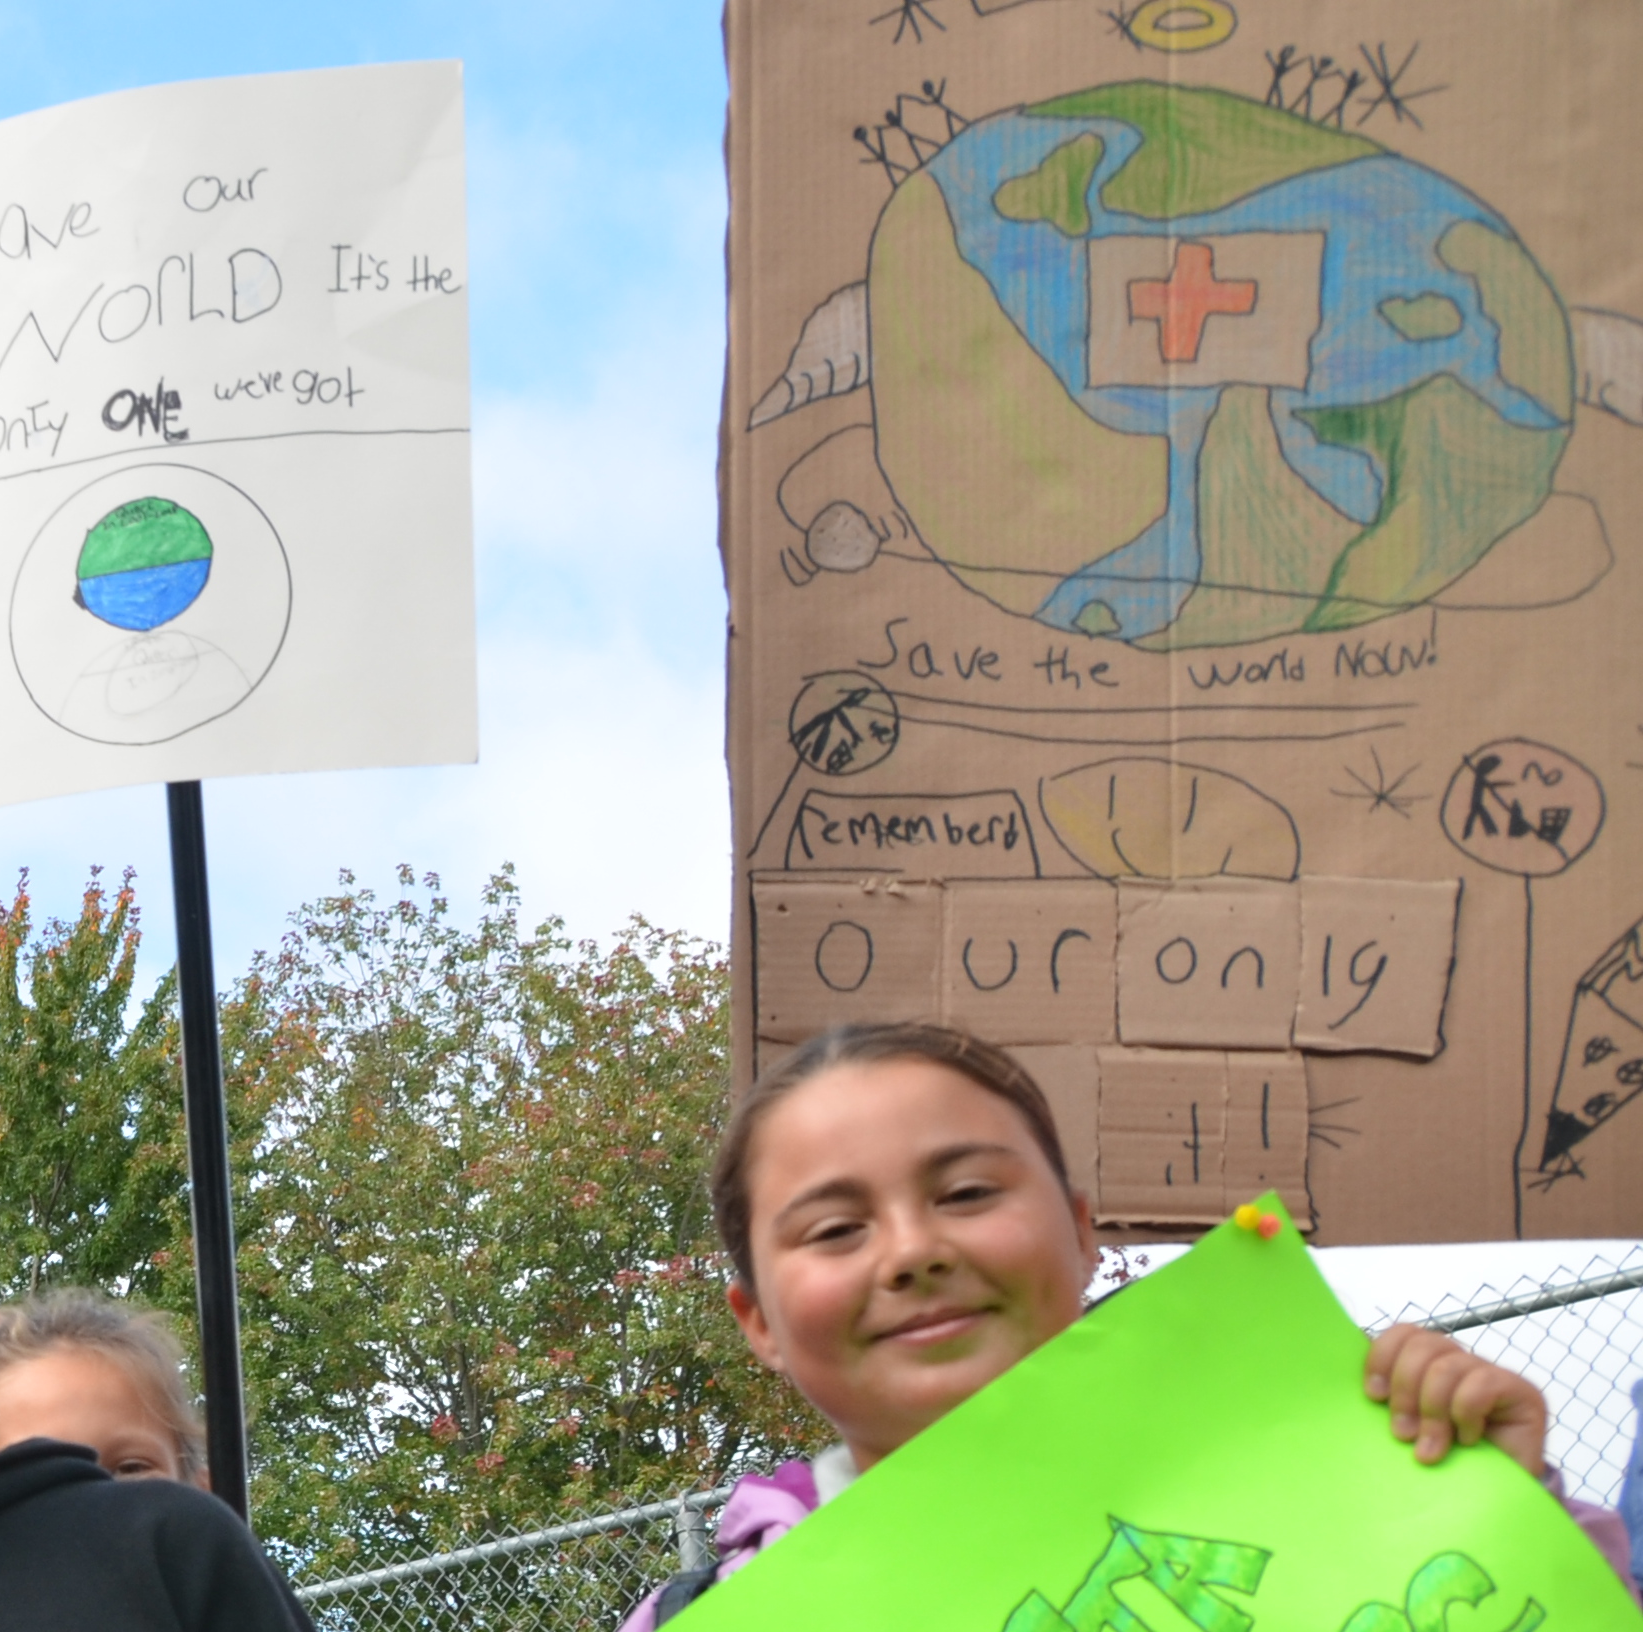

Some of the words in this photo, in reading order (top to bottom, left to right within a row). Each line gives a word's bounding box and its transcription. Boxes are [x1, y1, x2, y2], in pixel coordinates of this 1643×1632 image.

[181, 167, 270, 212] our
[326, 243, 391, 294] It's
[404, 253, 464, 296] the
[101, 374, 191, 443] ONE
[291, 365, 367, 407] got
[855, 616, 1003, 681] Save
[1033, 645, 1120, 691] the
[1188, 647, 1306, 690] world
[1334, 608, 1439, 680] NOW!
